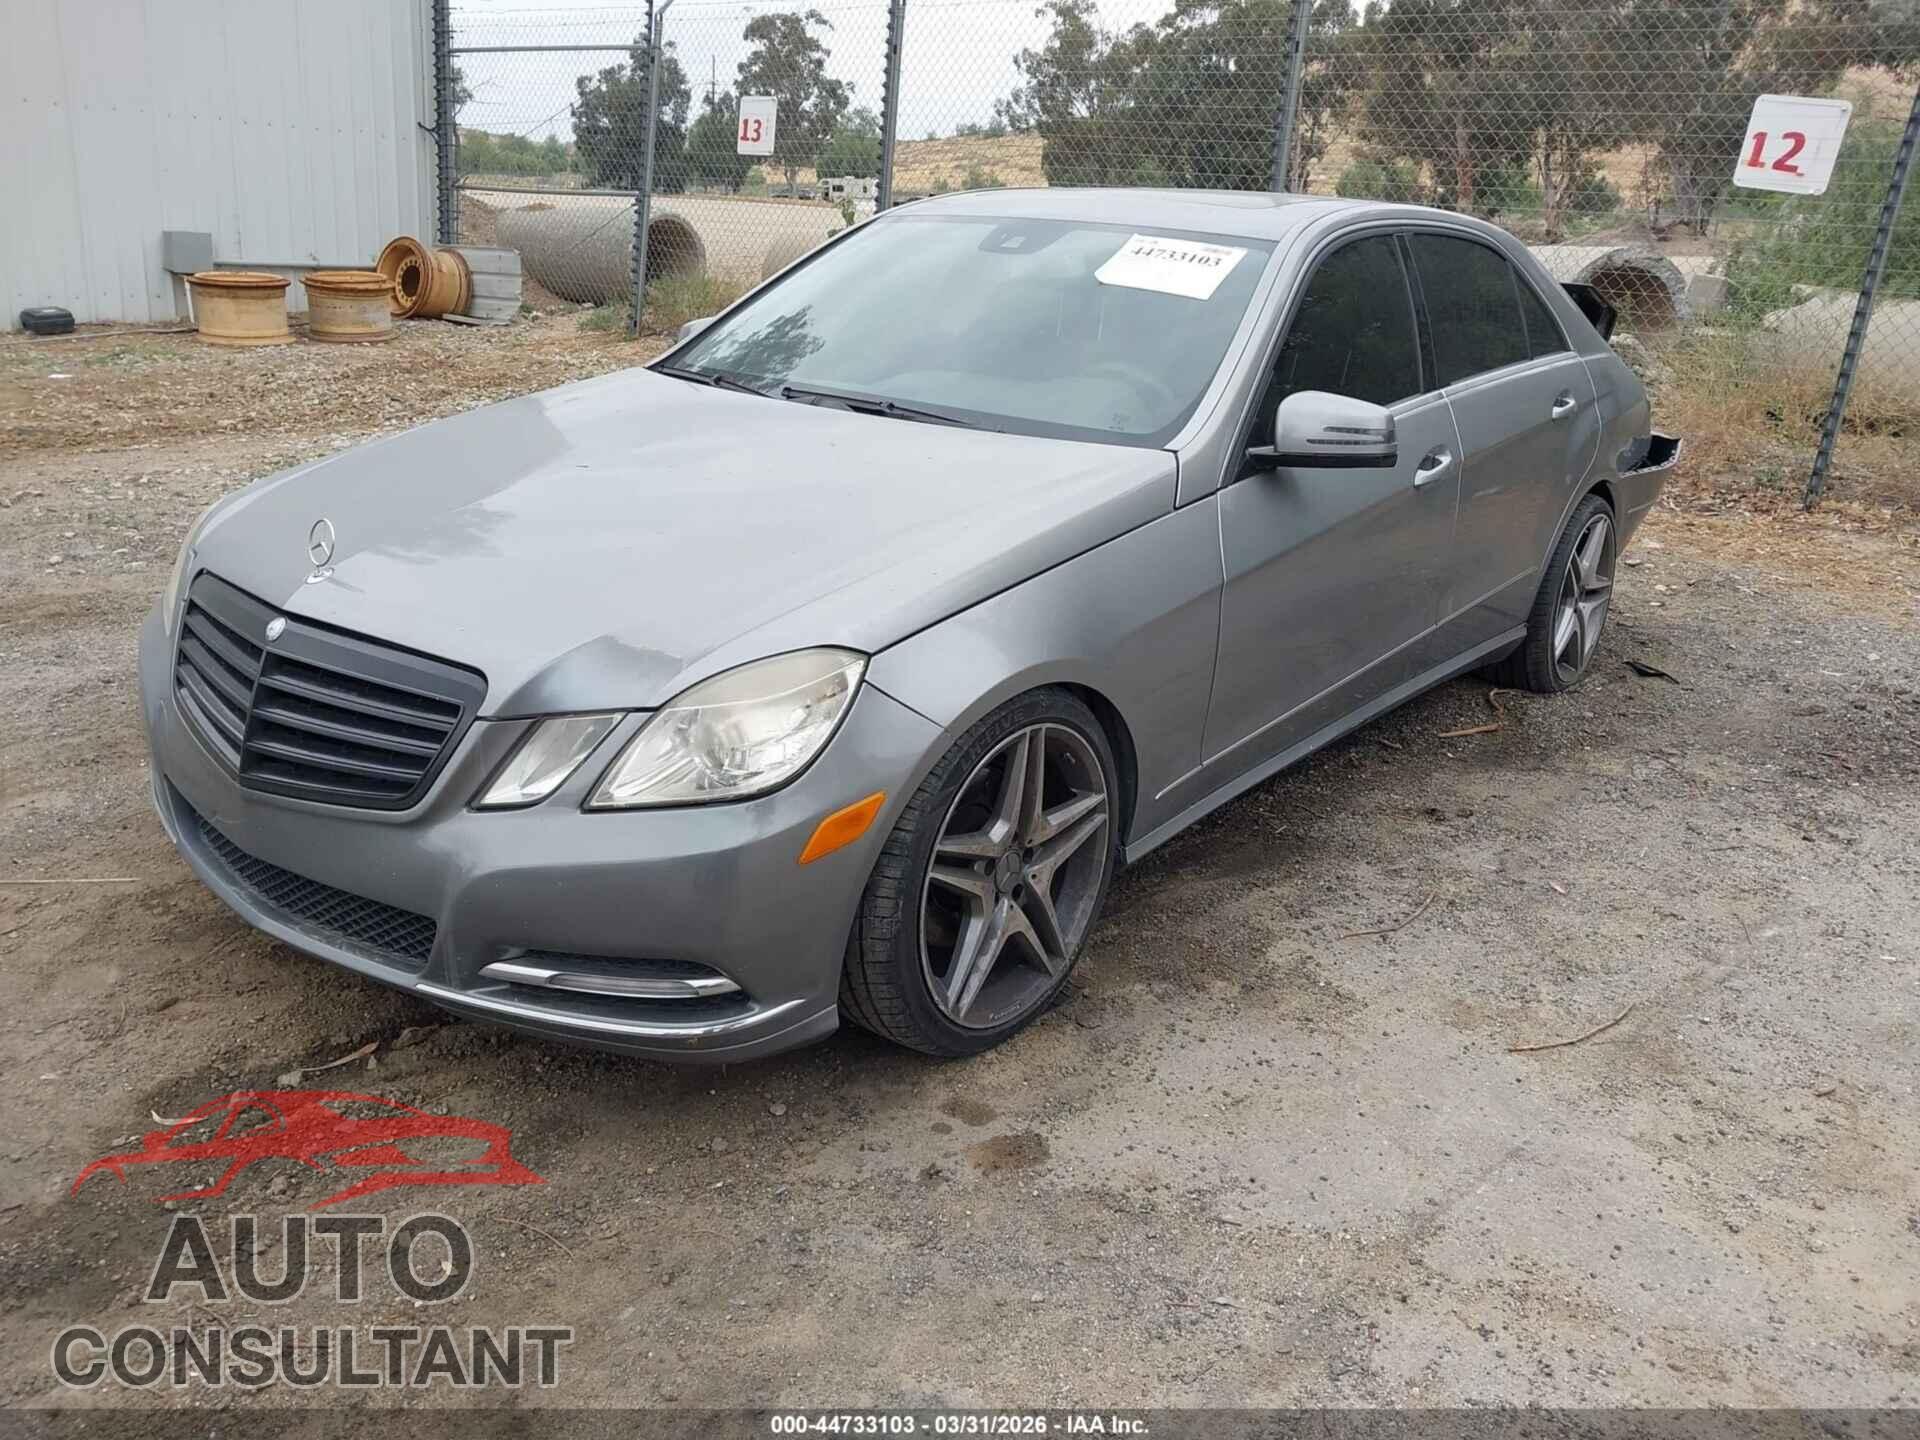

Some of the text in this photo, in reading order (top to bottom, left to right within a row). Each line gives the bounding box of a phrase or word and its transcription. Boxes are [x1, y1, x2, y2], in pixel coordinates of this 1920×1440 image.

[740, 118, 762, 143] 13
[1747, 131, 1806, 174] 12
[1131, 246, 1222, 267] 44733103
